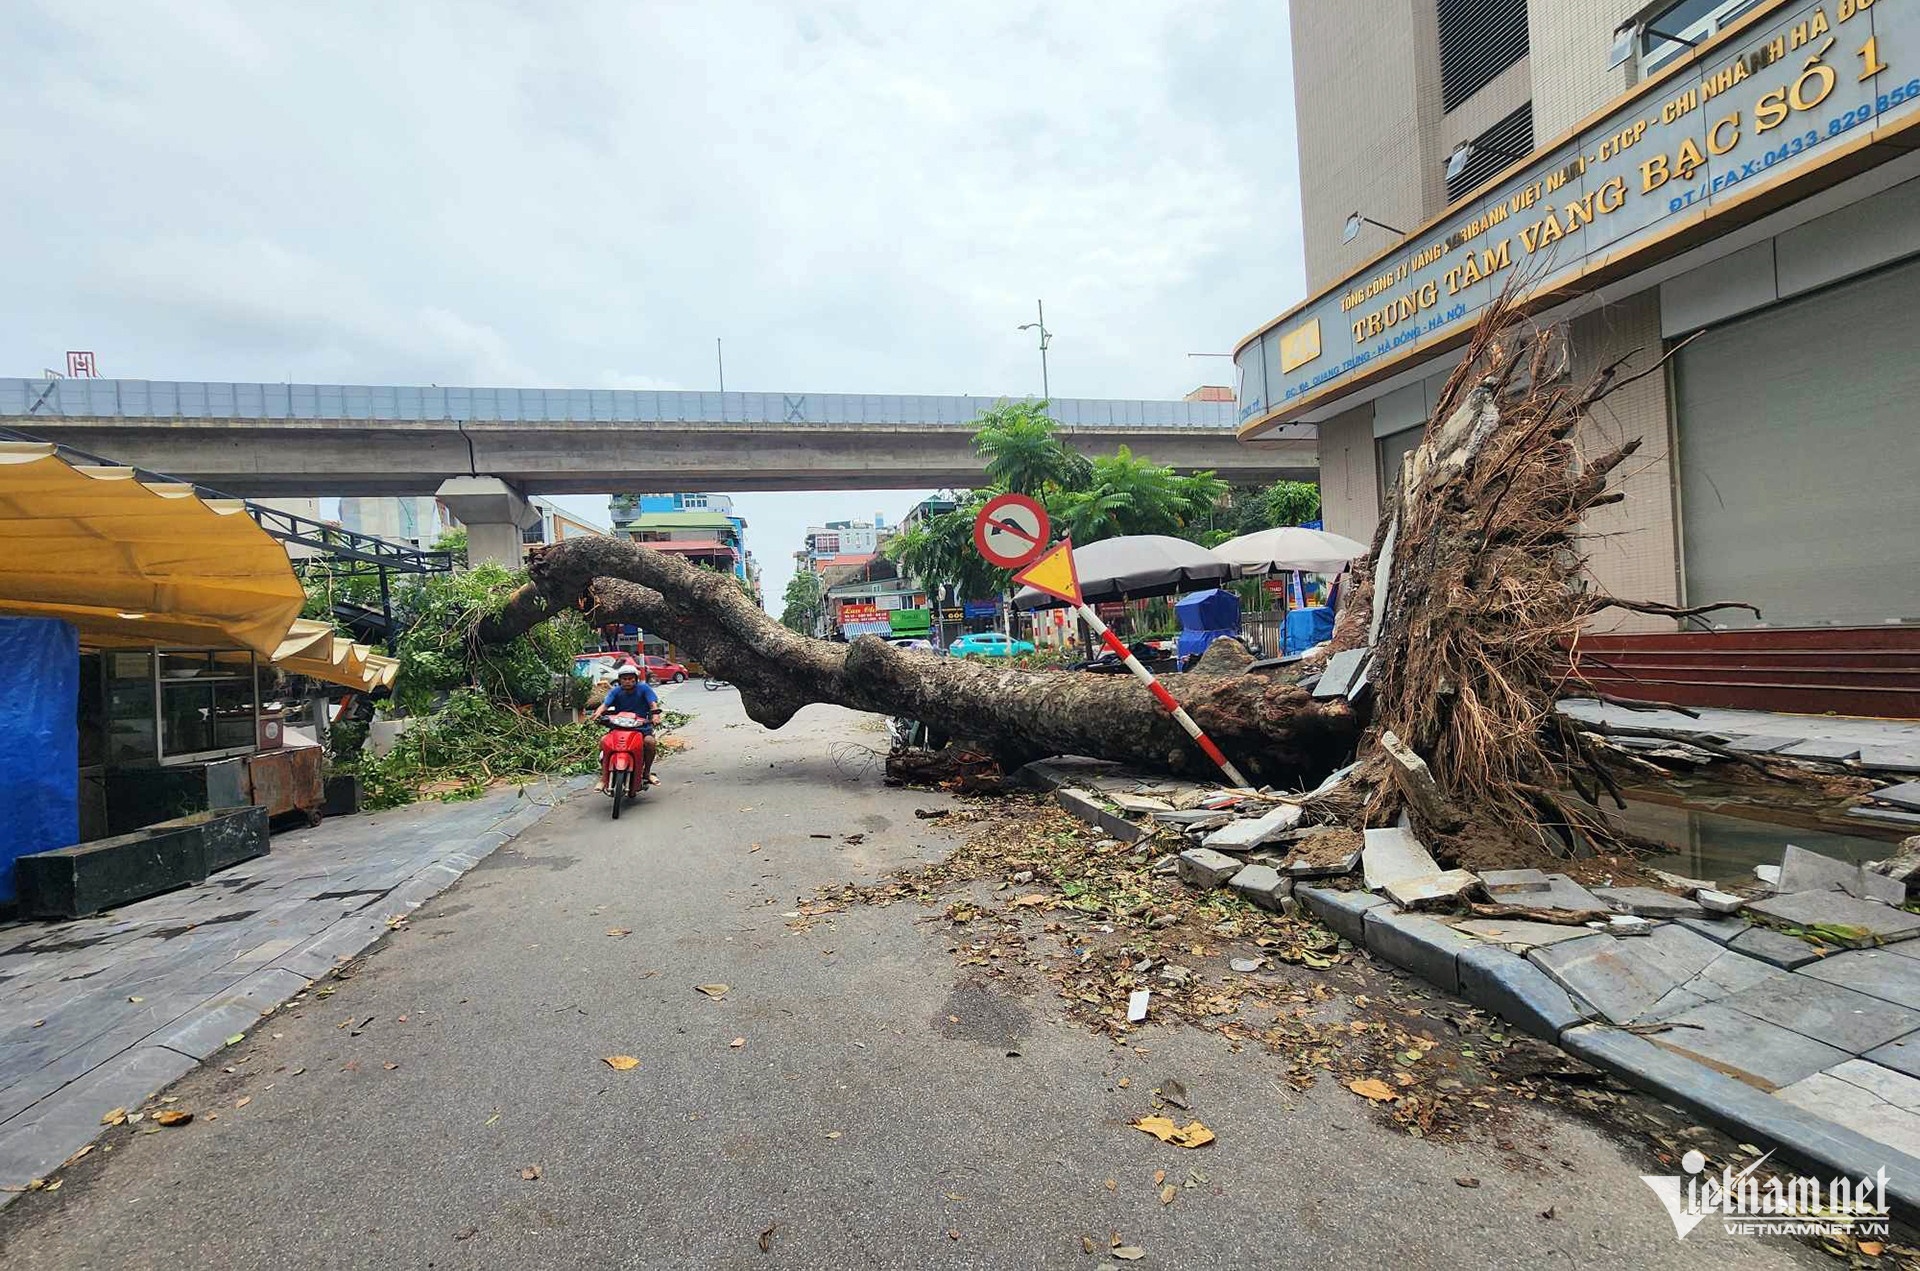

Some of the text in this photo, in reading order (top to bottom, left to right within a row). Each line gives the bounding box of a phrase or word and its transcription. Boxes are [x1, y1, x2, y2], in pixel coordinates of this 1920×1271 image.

[1351, 36, 1888, 343] TRUNG TÂM VÀNG BẠC SỐ 1
[1366, 277, 1394, 299] CÔNG
[1397, 262, 1409, 281] TY
[1511, 182, 1542, 213] VIỆT
[1599, 120, 1647, 162] CTCP
[1662, 89, 1697, 125] CHI
[1791, 8, 1829, 52] HÀ
[1312, 366, 1340, 385] QUANG
[1342, 351, 1370, 371] TRUNG
[1377, 337, 1391, 354] HÀ
[1429, 312, 1443, 330] HÀ
[1447, 303, 1466, 321] NỘI
